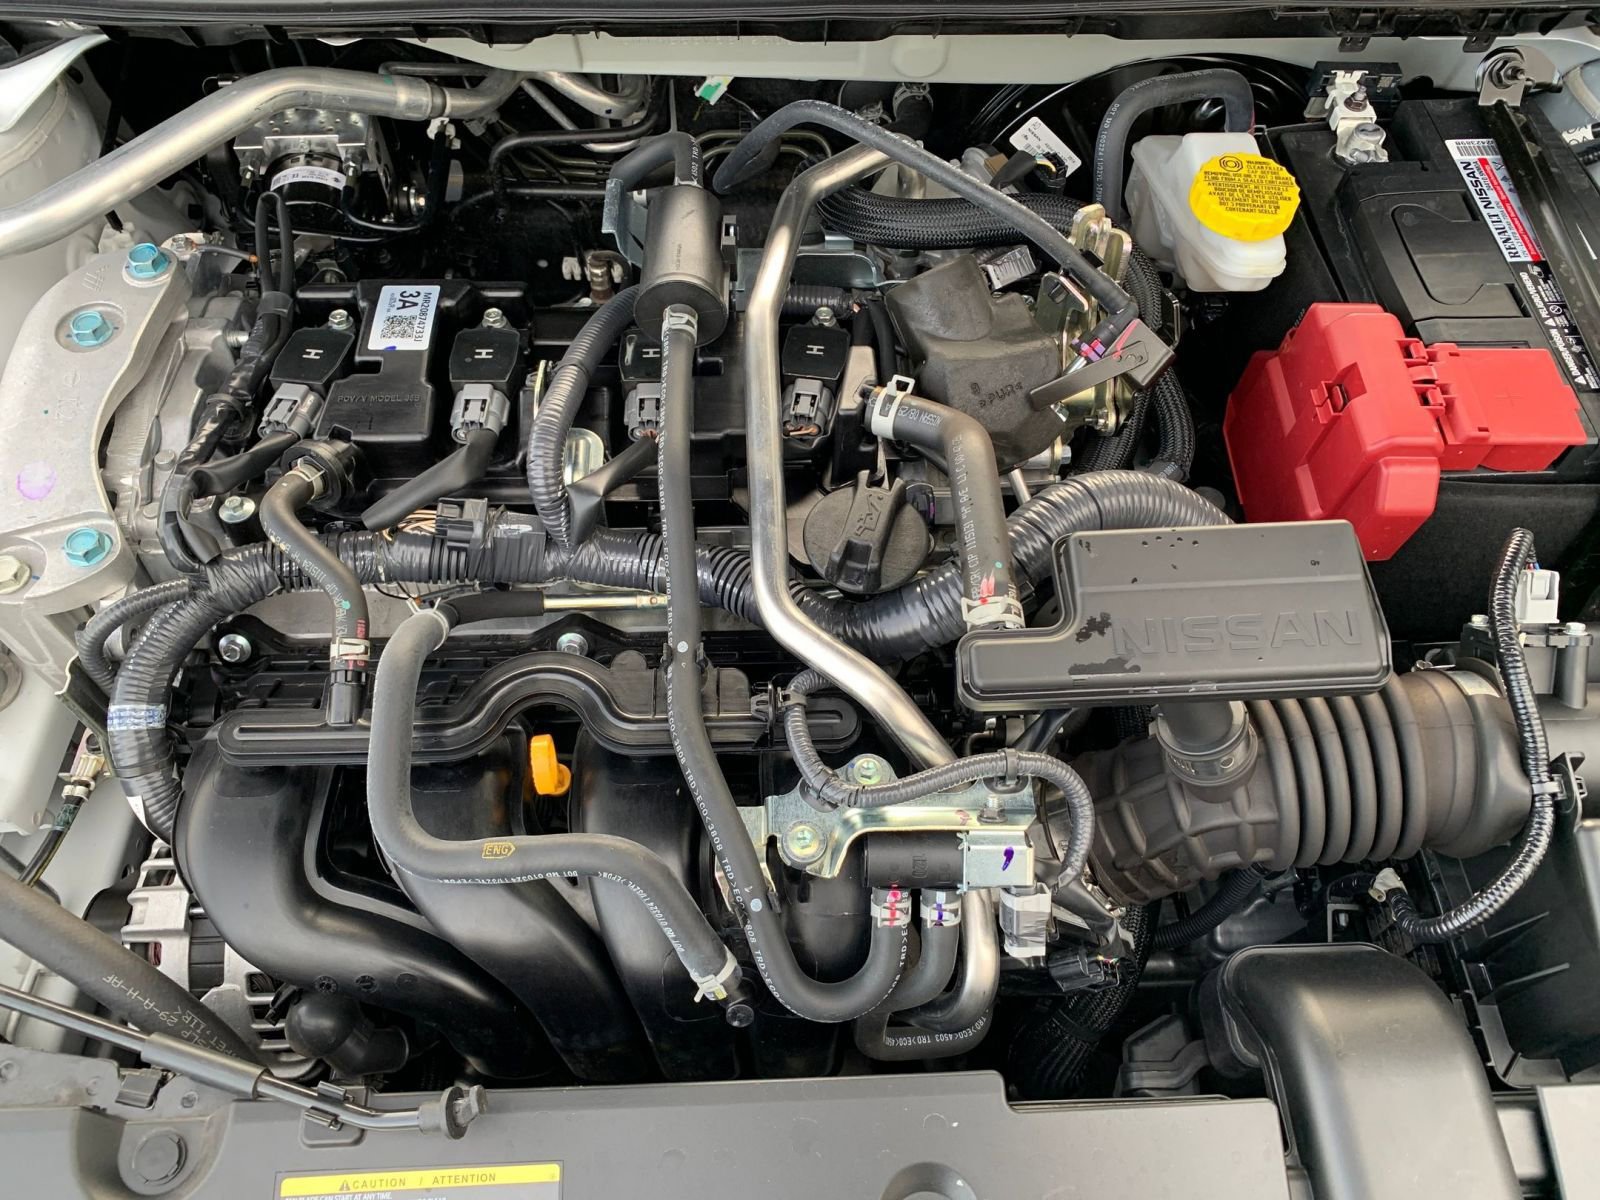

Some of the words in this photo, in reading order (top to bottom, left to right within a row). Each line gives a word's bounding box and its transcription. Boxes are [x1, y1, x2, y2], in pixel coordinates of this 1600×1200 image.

[1460, 161, 1495, 210] NISSAN
[1487, 213, 1521, 259] RENAULT
[396, 290, 421, 310] 3A
[1112, 610, 1361, 656] NISSAN
[485, 845, 510, 855] ENG
[352, 1178, 406, 1190] CAUTION
[432, 1173, 496, 1185] ATTENTION
